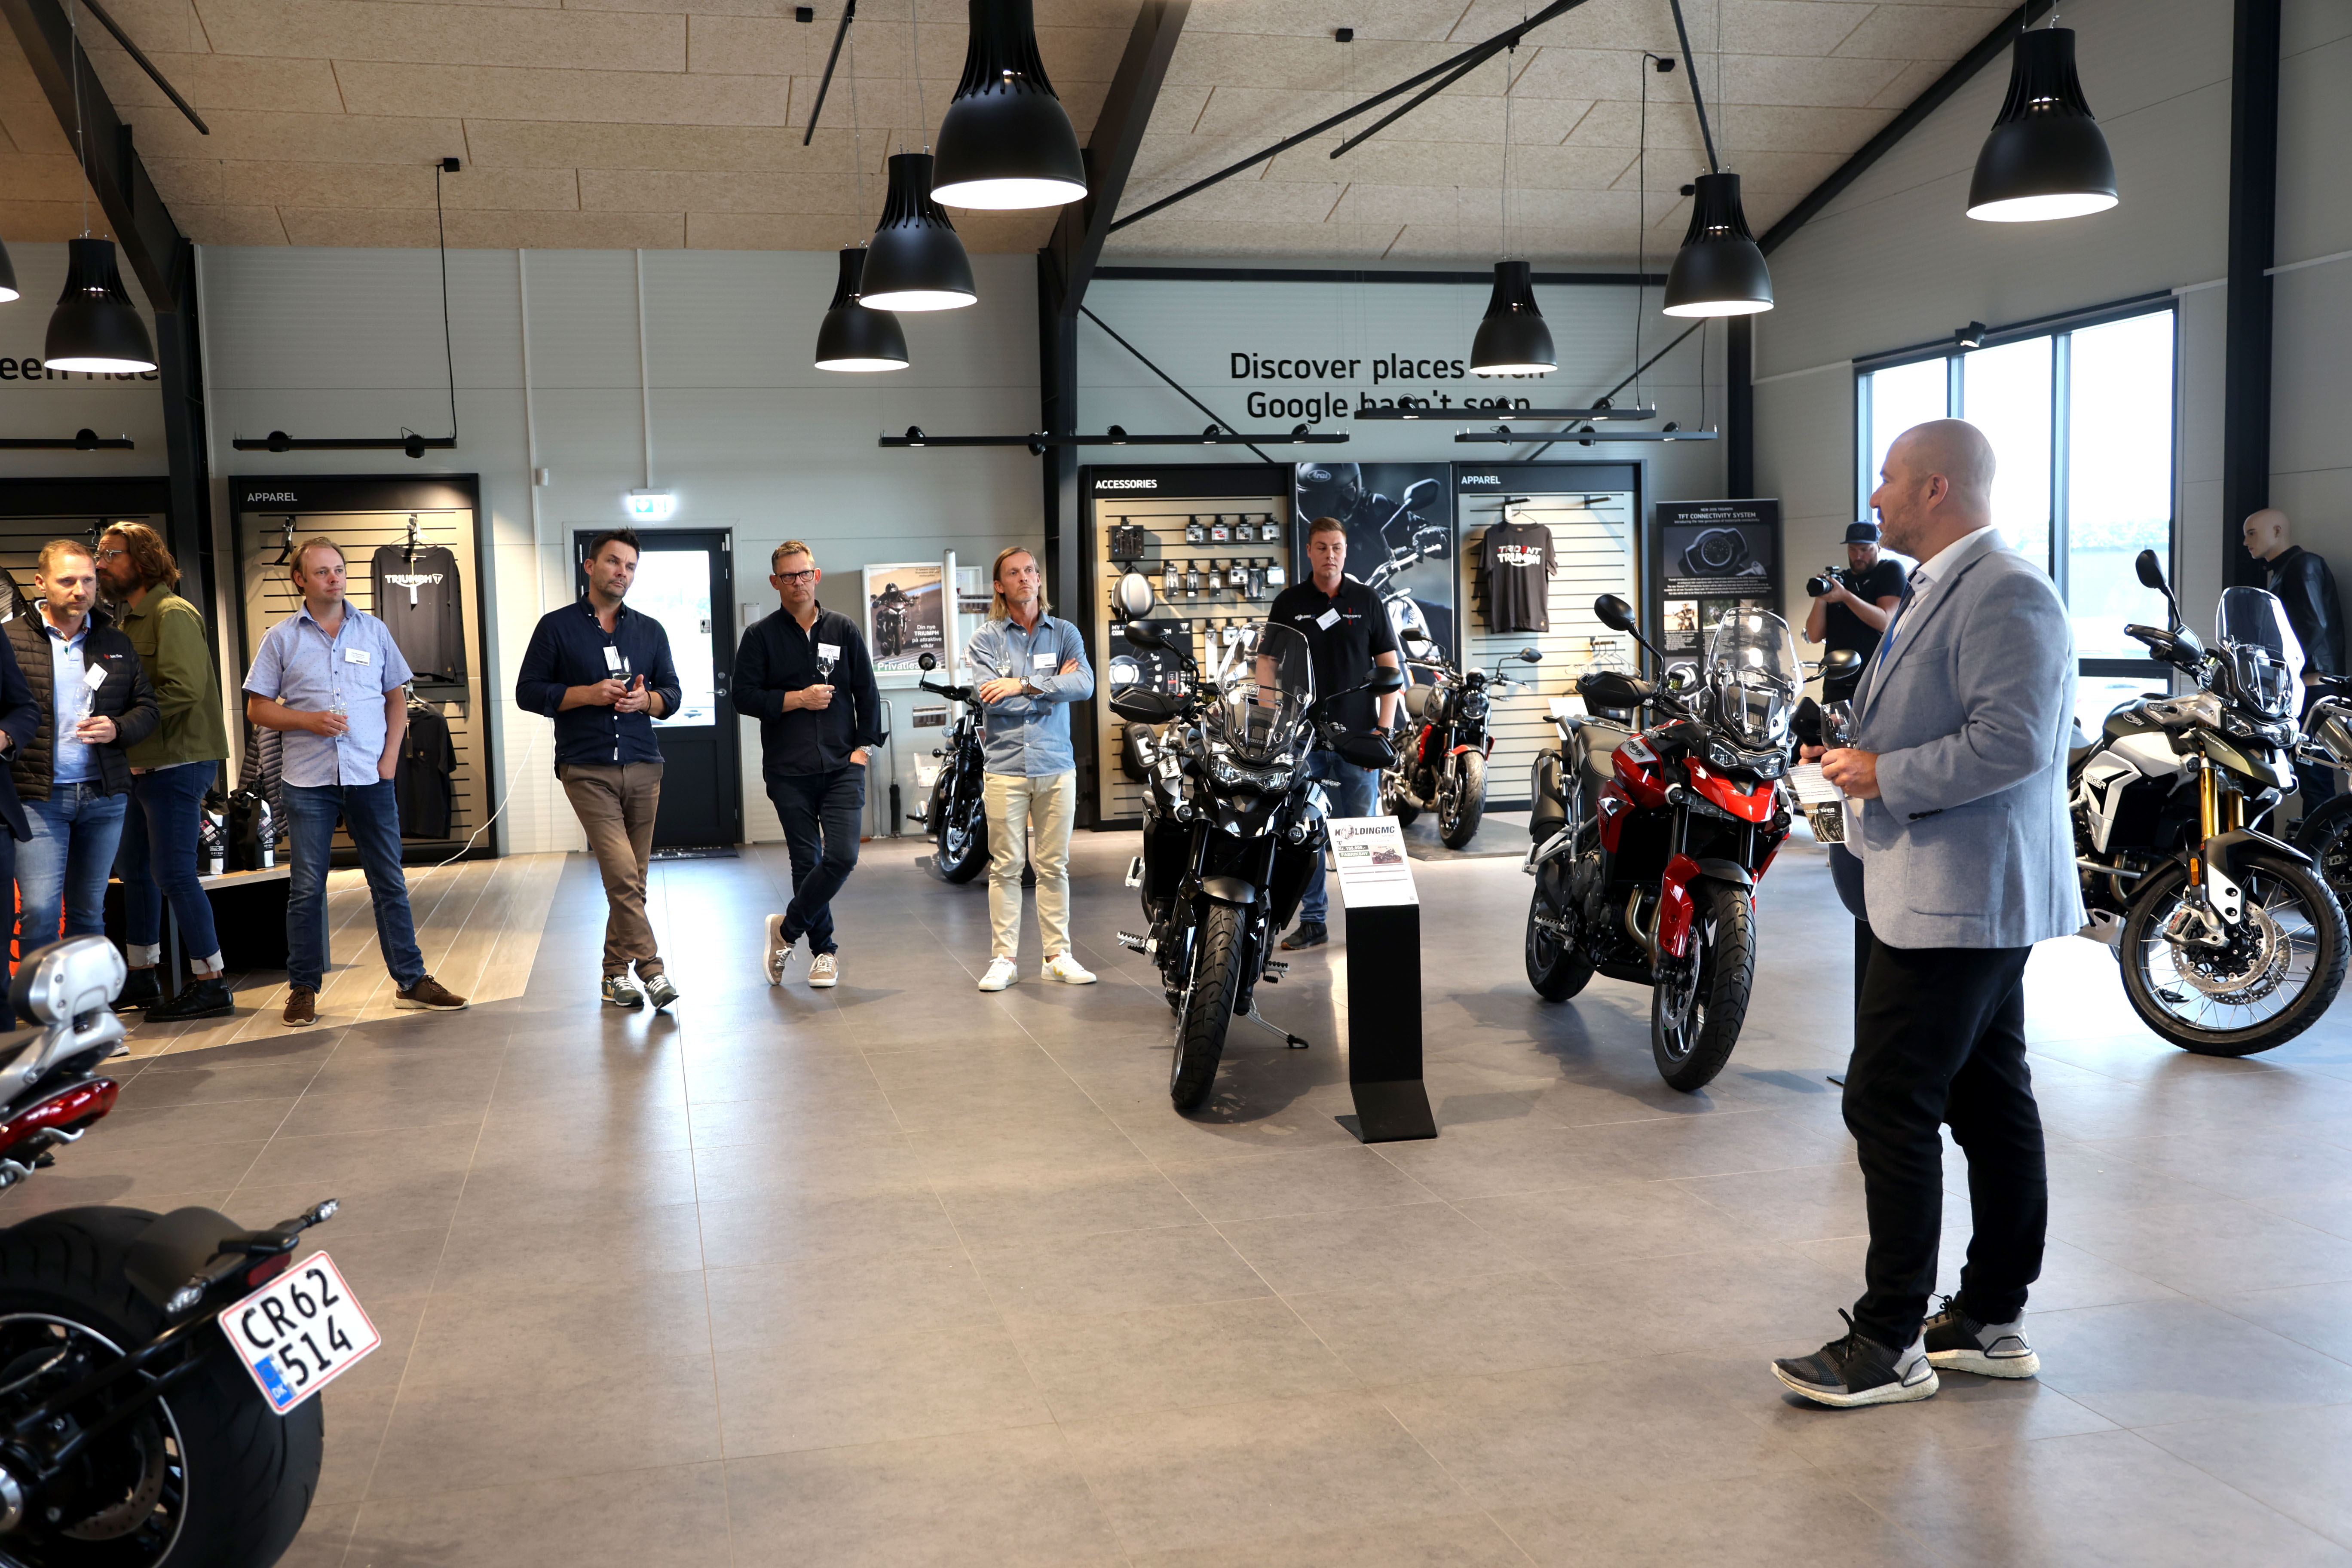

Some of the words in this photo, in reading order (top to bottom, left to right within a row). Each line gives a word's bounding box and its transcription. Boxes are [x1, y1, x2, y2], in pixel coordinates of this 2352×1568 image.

[1231, 352, 1361, 379] Discover
[1372, 353, 1465, 385] places
[1247, 391, 1348, 424] Google
[1360, 389, 1452, 409] han't
[1464, 397, 1531, 410] sen
[1095, 479, 1158, 489] ACCESSORIES
[1461, 475, 1501, 484] APPAREL
[247, 492, 298, 502] APPAREL
[1498, 545, 1542, 555] TRIDENT
[1497, 552, 1541, 567] TRIUMPH
[385, 574, 432, 587] TRIUMPH
[877, 662, 941, 671] Privatleag
[1627, 741, 1646, 758] TRIUMPH
[2086, 772, 2107, 790] TIGER
[278, 1314, 354, 1387] 514
[272, 1383, 288, 1400] DK
